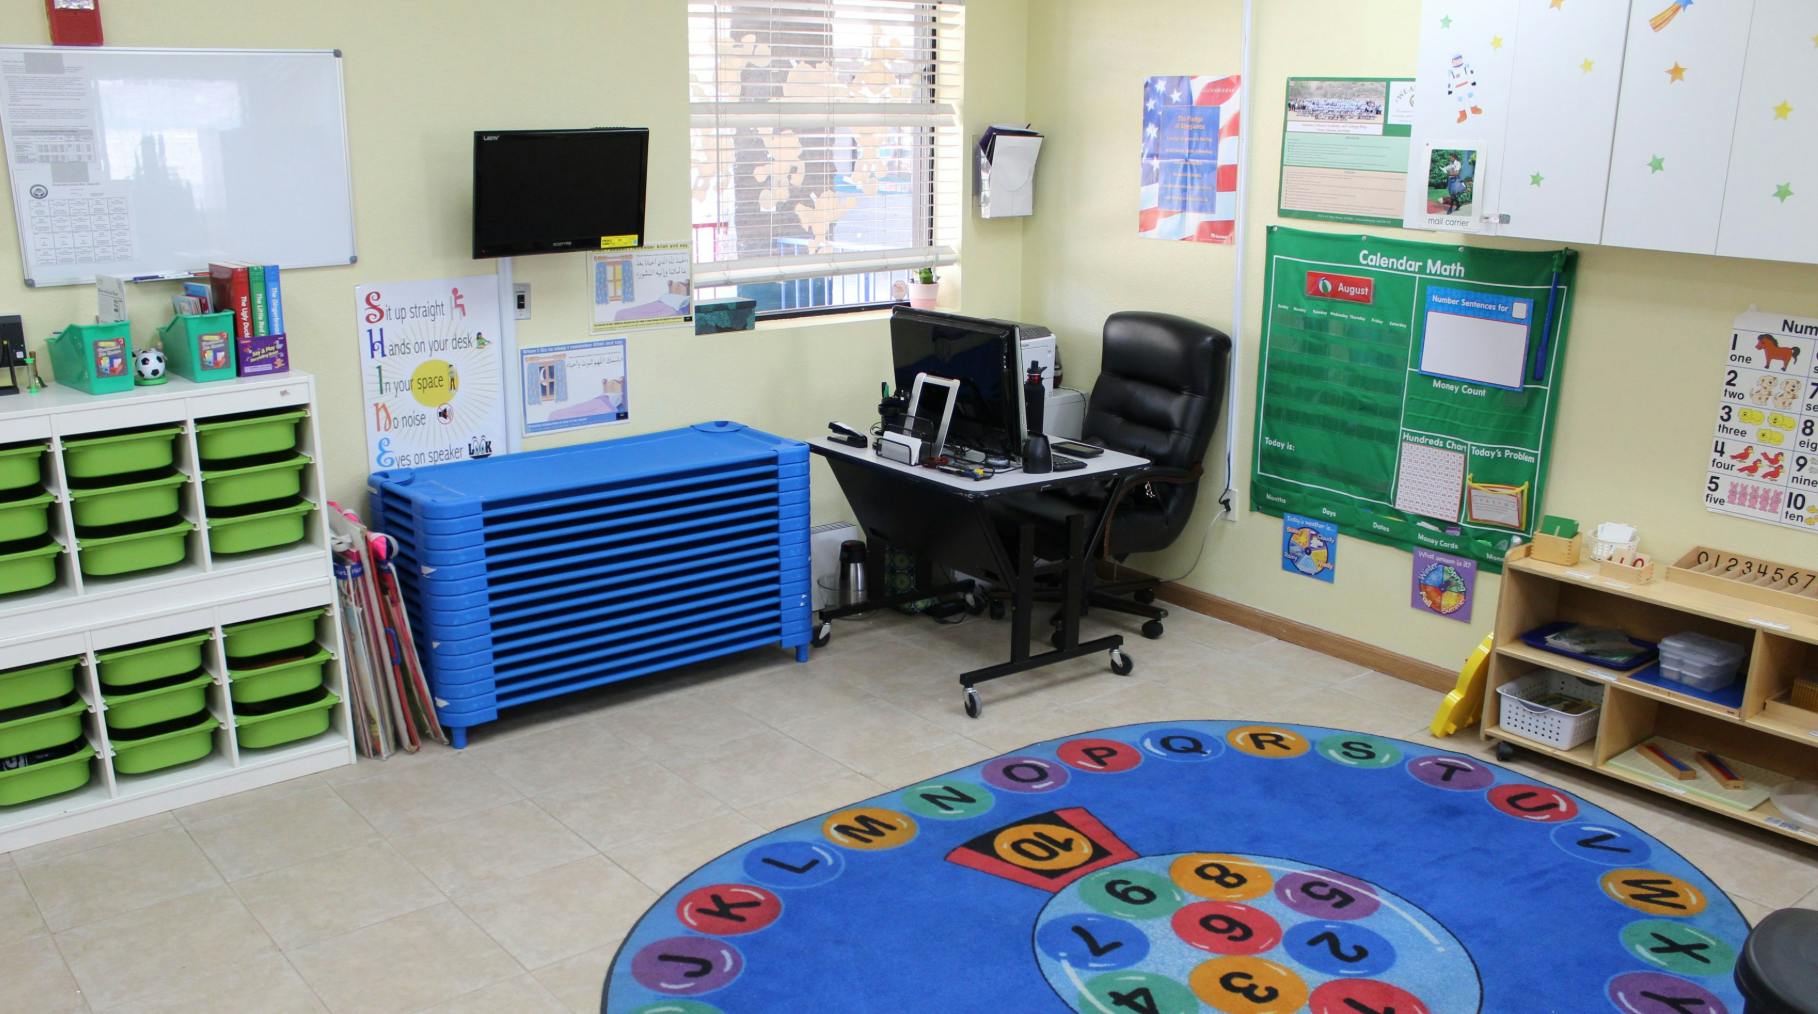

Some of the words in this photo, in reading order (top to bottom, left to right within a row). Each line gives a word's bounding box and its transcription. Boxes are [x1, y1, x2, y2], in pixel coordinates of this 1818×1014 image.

[1428, 217, 1444, 225] mail
[1445, 218, 1470, 227] carrier
[1359, 250, 1423, 272] Calendar
[1426, 259, 1465, 278] Math
[1338, 282, 1369, 296] August
[364, 291, 392, 324] Sit
[395, 307, 406, 325] up
[410, 300, 446, 322] straight
[1432, 295, 1460, 306] Number
[1461, 298, 1497, 312] Sentences
[1498, 303, 1509, 313] for
[241, 308, 249, 322] Ugly
[366, 328, 412, 359] Hands
[414, 340, 426, 354] on
[428, 338, 449, 358] your
[451, 333, 473, 351] desk
[1731, 333, 1738, 350] 1
[1730, 354, 1752, 364] one
[376, 364, 391, 394] In
[393, 379, 414, 398] your
[416, 374, 444, 394] space
[1725, 369, 1738, 387] 2
[1433, 379, 1459, 393] Money
[1461, 384, 1486, 397] Count
[1723, 388, 1745, 400] two
[402, 411, 427, 430] noise
[1720, 405, 1732, 422] 3
[1718, 424, 1747, 437] three
[1802, 419, 1815, 437] 8
[1265, 437, 1285, 450] Today
[1287, 442, 1295, 451] is:
[1402, 432, 1444, 447] Hundreds
[1714, 440, 1725, 457] 4
[376, 437, 412, 470] Eyes
[414, 452, 426, 466] on
[428, 443, 464, 465] speaker
[1471, 446, 1502, 459] Today's
[1504, 448, 1535, 463] Problem
[1711, 458, 1735, 472] four
[1795, 455, 1808, 472] 9
[1707, 475, 1720, 492] 5
[1791, 476, 1818, 487] nine
[1266, 493, 1286, 504] Months
[1705, 493, 1725, 506] five
[1786, 492, 1806, 511] 10
[1322, 507, 1337, 518] Days
[1785, 510, 1804, 522] ten
[1372, 521, 1390, 533] Dates
[1418, 533, 1440, 546] Money
[1440, 540, 1458, 550] Cards
[1418, 551, 1435, 560] What
[1418, 562, 1438, 580] Winter
[1446, 566, 1466, 592] Spring
[1725, 557, 1739, 572] 2
[1741, 560, 1753, 575] 3
[1757, 563, 1768, 577] 4
[1771, 567, 1785, 582] 5
[1787, 571, 1799, 586] 6
[1803, 574, 1817, 589] 7
[1420, 591, 1433, 608] Fall
[1441, 594, 1466, 614] Summer
[1160, 735, 1208, 755] Q
[1249, 732, 1291, 750] R
[1081, 746, 1118, 768] P
[1341, 741, 1377, 761] S
[1002, 763, 1049, 783] O
[1436, 761, 1473, 782] T
[920, 786, 977, 811] N
[1507, 791, 1559, 812] U
[834, 814, 897, 844] M
[1010, 831, 1075, 862] 10
[1576, 834, 1632, 854] V
[762, 857, 820, 874] L
[1194, 862, 1248, 889] 8
[1300, 880, 1356, 909] 5
[695, 893, 762, 922] K
[1071, 925, 1123, 957] 7
[1306, 931, 1369, 963] 2
[1650, 932, 1711, 964] X
[658, 953, 713, 978] J
[1219, 971, 1279, 1004] 3
